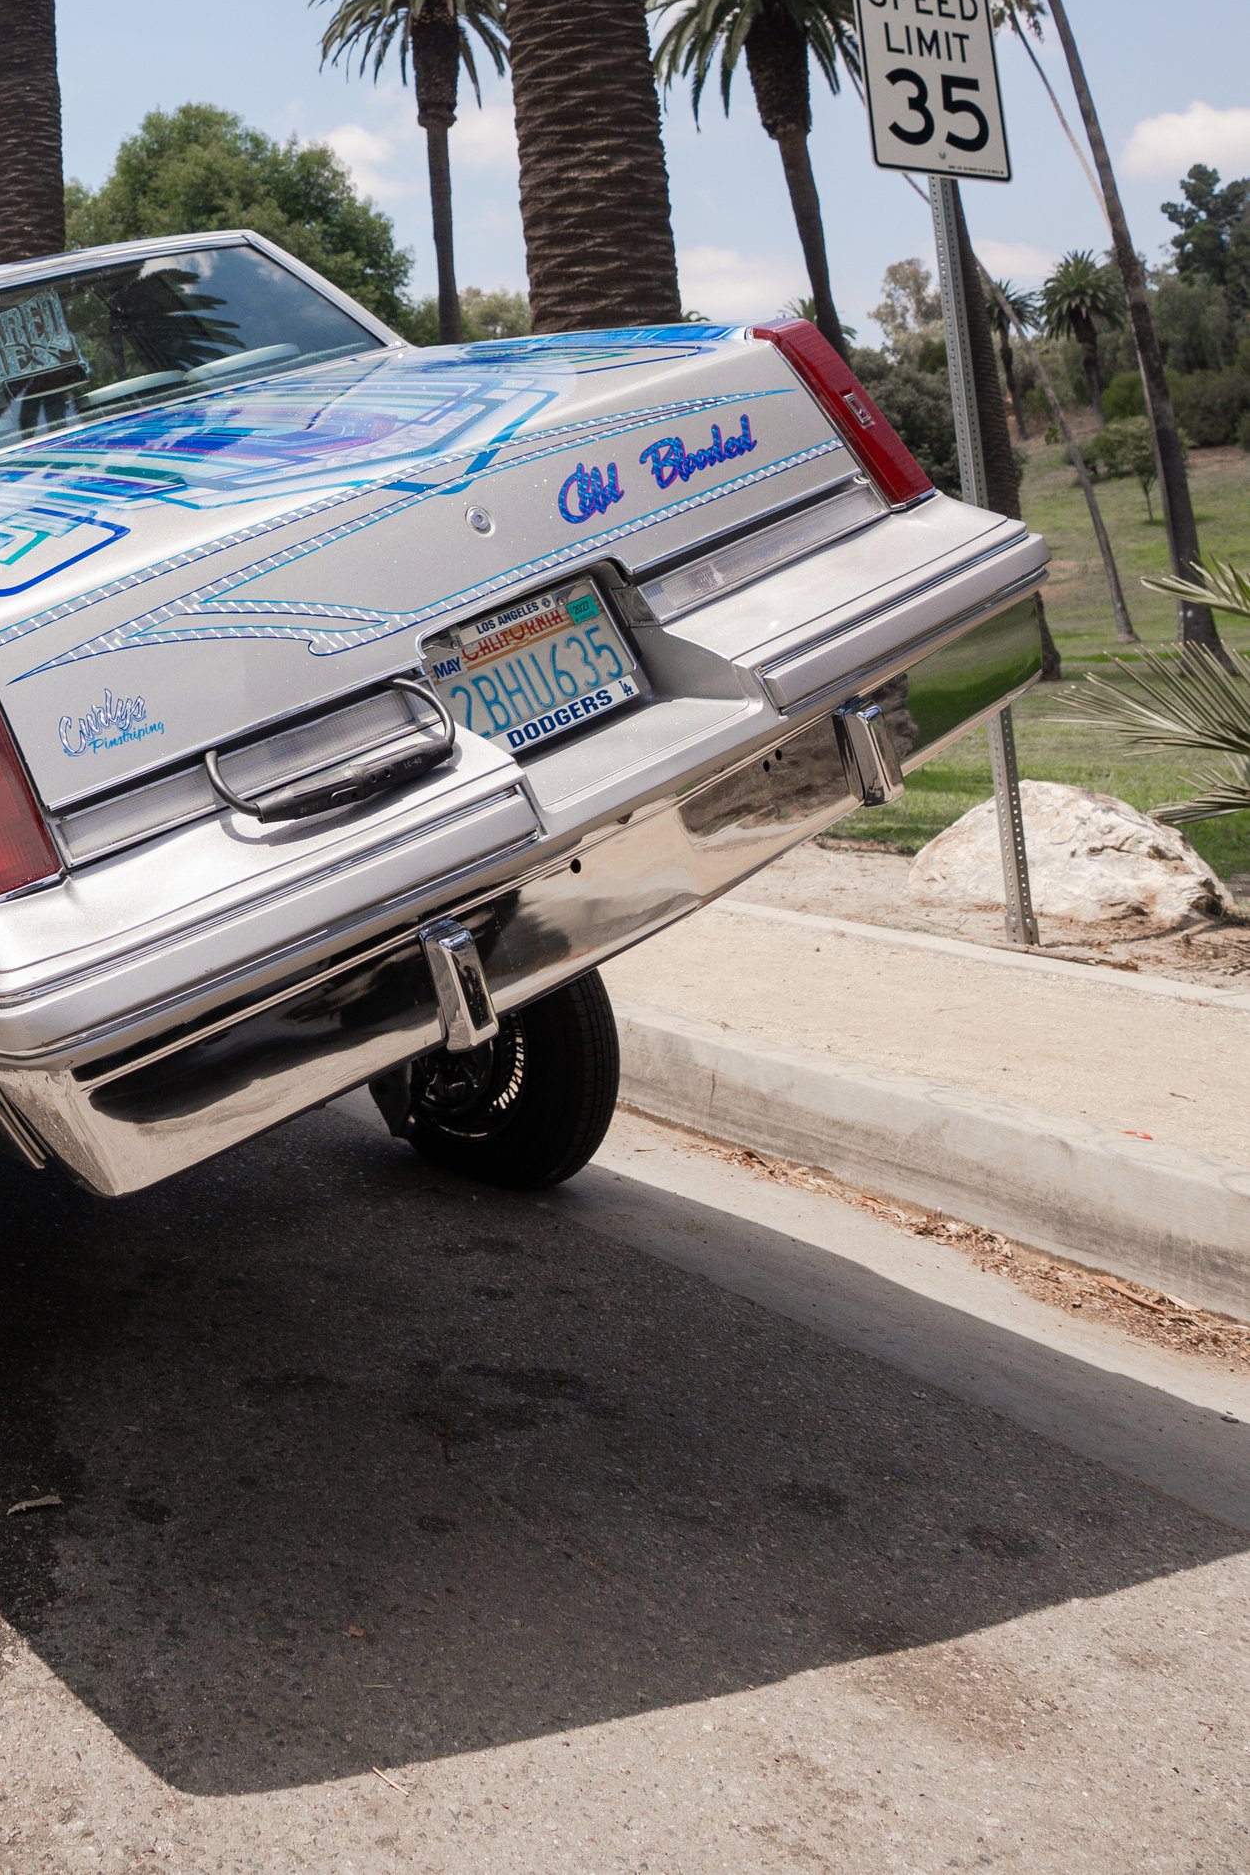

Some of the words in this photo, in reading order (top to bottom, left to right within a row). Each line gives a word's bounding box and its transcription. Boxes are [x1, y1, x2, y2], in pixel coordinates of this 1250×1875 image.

[884, 22, 970, 63] LIMIT
[885, 68, 989, 153] 35
[558, 462, 625, 524] Cold
[639, 414, 758, 490] Blooded
[475, 619, 497, 634] LOS
[498, 602, 540, 626] ANGELES
[572, 600, 590, 615] 2027
[432, 656, 463, 679] MAY
[450, 625, 623, 738] 2BHU635
[58, 688, 147, 757] Curlys
[88, 722, 165, 755] Pinstriping
[506, 689, 613, 748] DODGERS
